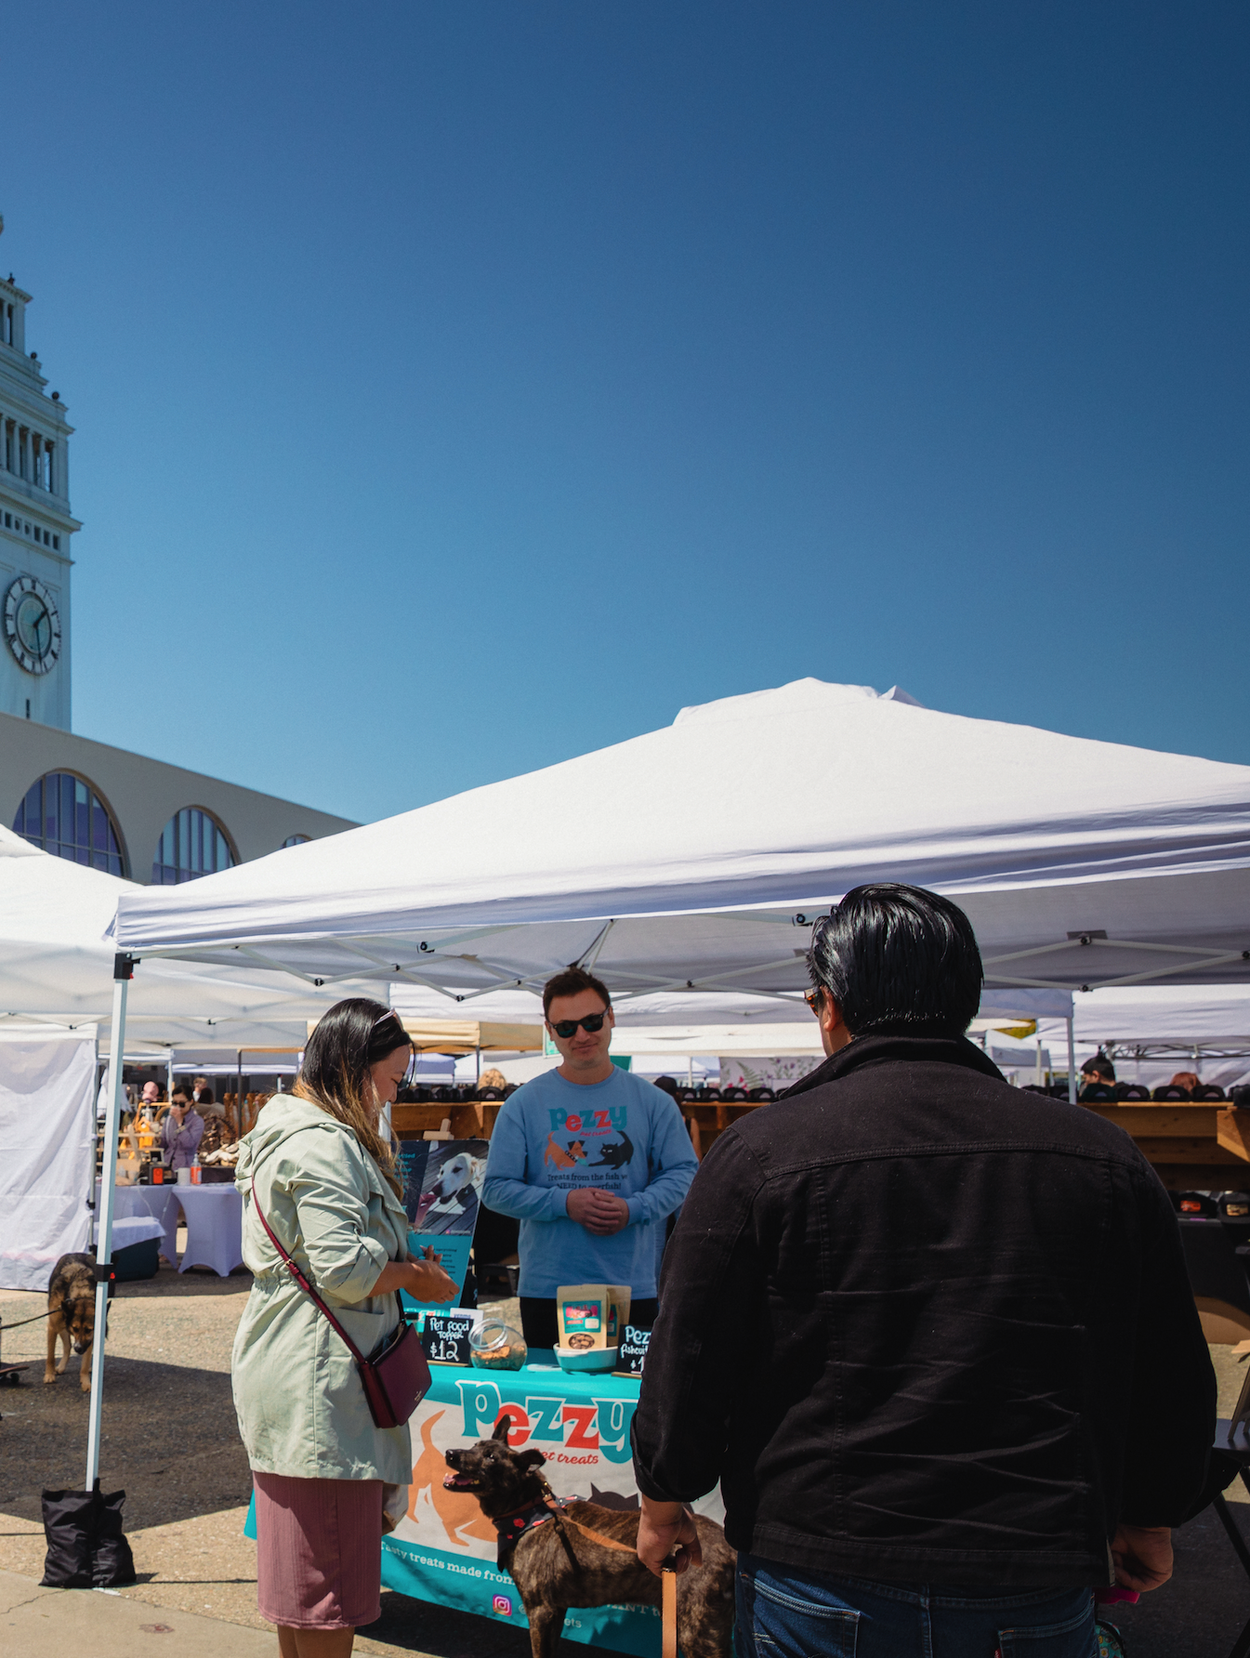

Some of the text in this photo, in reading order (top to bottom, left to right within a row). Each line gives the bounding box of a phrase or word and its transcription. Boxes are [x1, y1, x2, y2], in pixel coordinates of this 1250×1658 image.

[547, 1173, 570, 1181] Treats
[570, 1173, 590, 1181] from
[591, 1173, 604, 1181] the
[605, 1172, 620, 1180] fish
[430, 1317, 470, 1333] Pet food
[430, 1340, 460, 1362] $12
[557, 1452, 599, 1465] treats
[381, 1542, 516, 1586] Tasty treats made from
